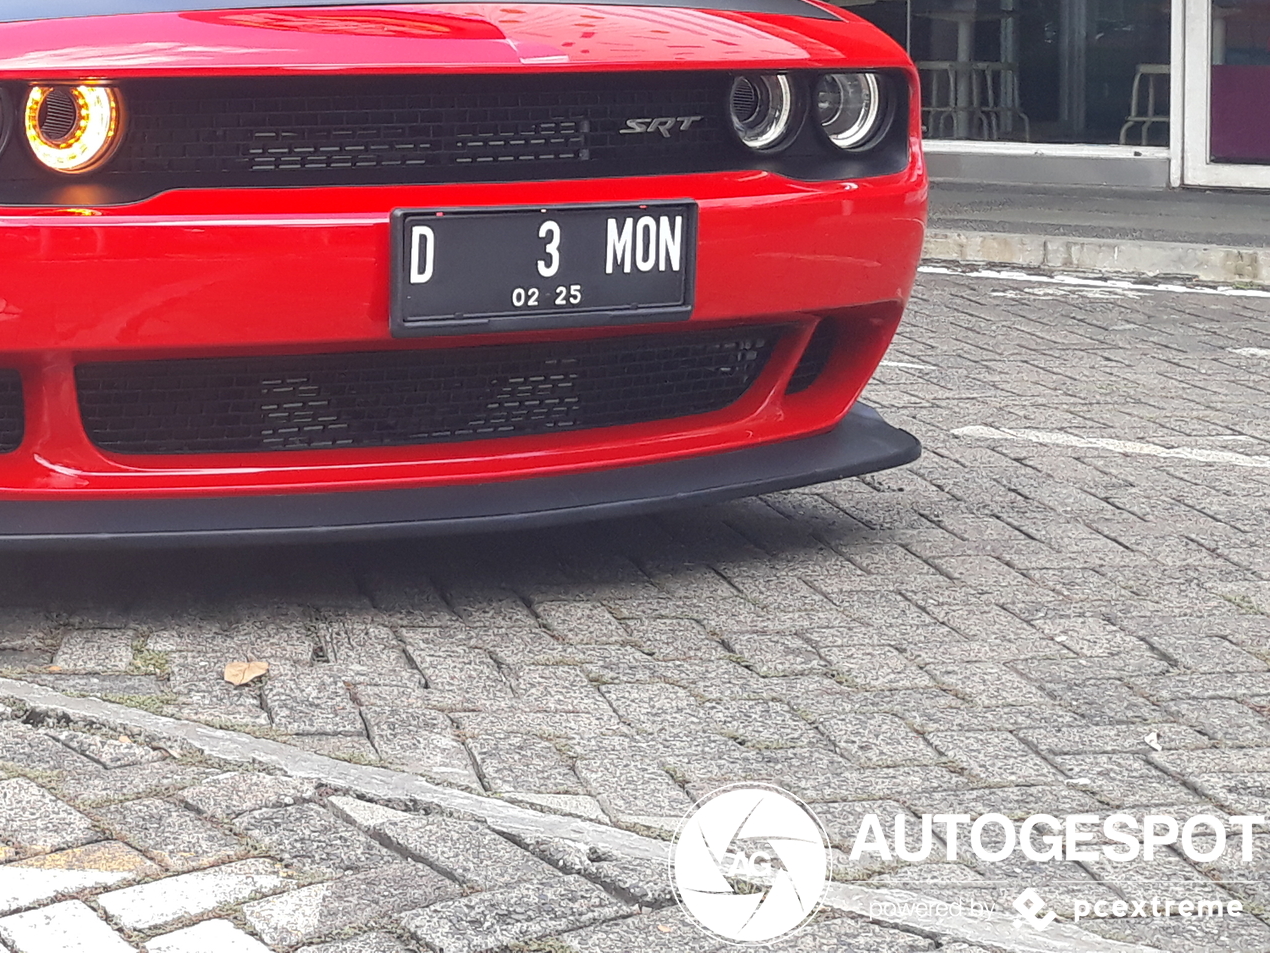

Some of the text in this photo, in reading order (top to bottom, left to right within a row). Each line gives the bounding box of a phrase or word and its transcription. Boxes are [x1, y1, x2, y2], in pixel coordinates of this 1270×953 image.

[619, 116, 704, 138] SRT
[410, 216, 683, 284] D 3 MON
[512, 285, 582, 307] 02 25
